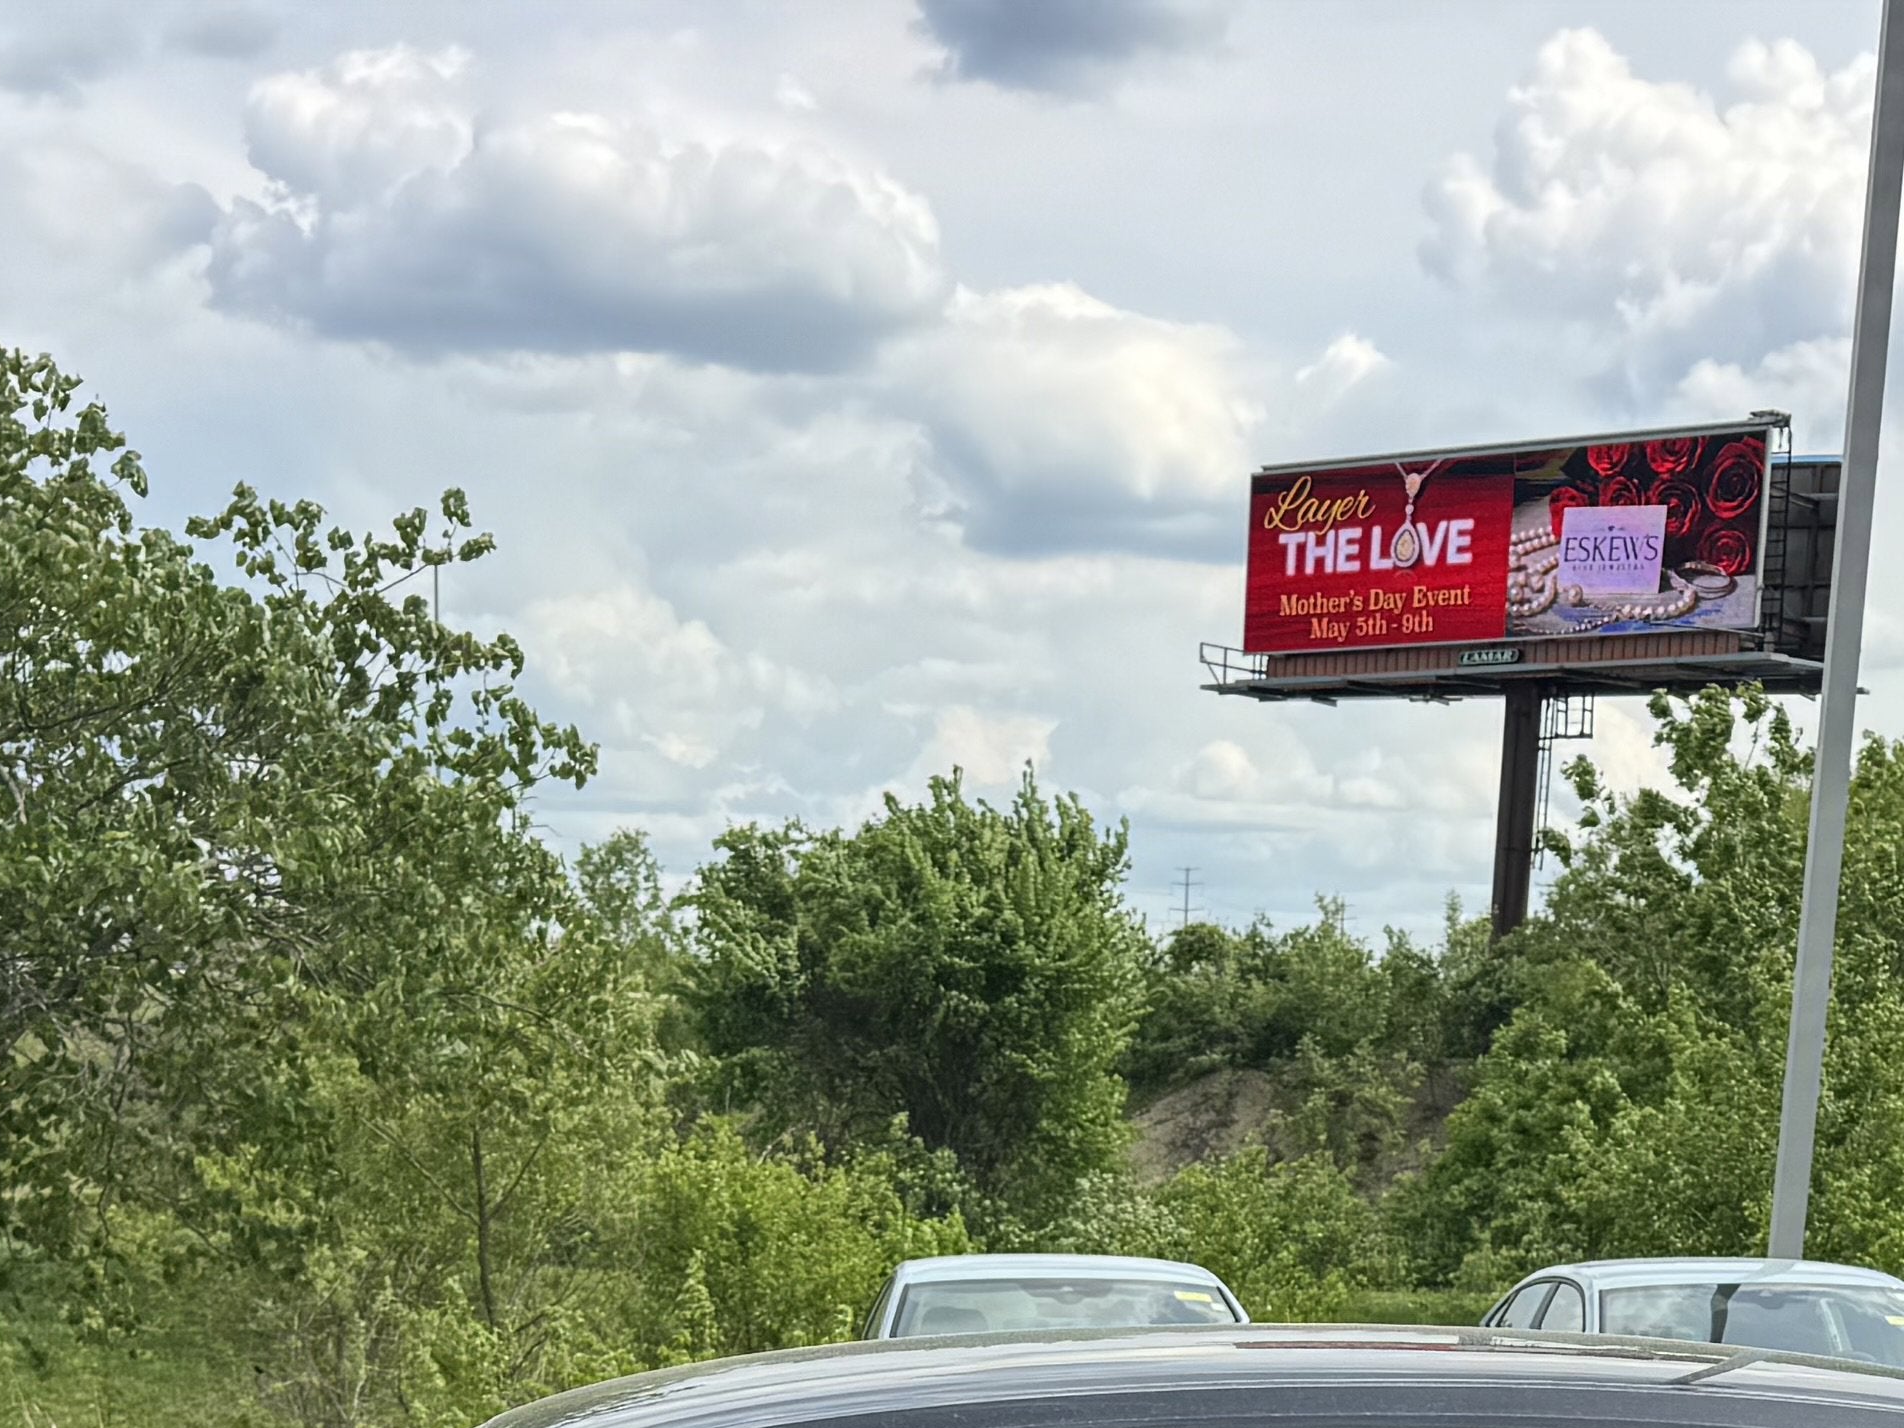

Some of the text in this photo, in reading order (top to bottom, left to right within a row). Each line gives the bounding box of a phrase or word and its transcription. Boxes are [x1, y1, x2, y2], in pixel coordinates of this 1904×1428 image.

[1264, 475, 1375, 535] Layer
[1279, 518, 1475, 576] THE LOVE
[1279, 584, 1471, 617] Mother's Day Event
[1309, 617, 1350, 642] May
[1356, 612, 1387, 637] 5th
[1402, 610, 1434, 634] 9th
